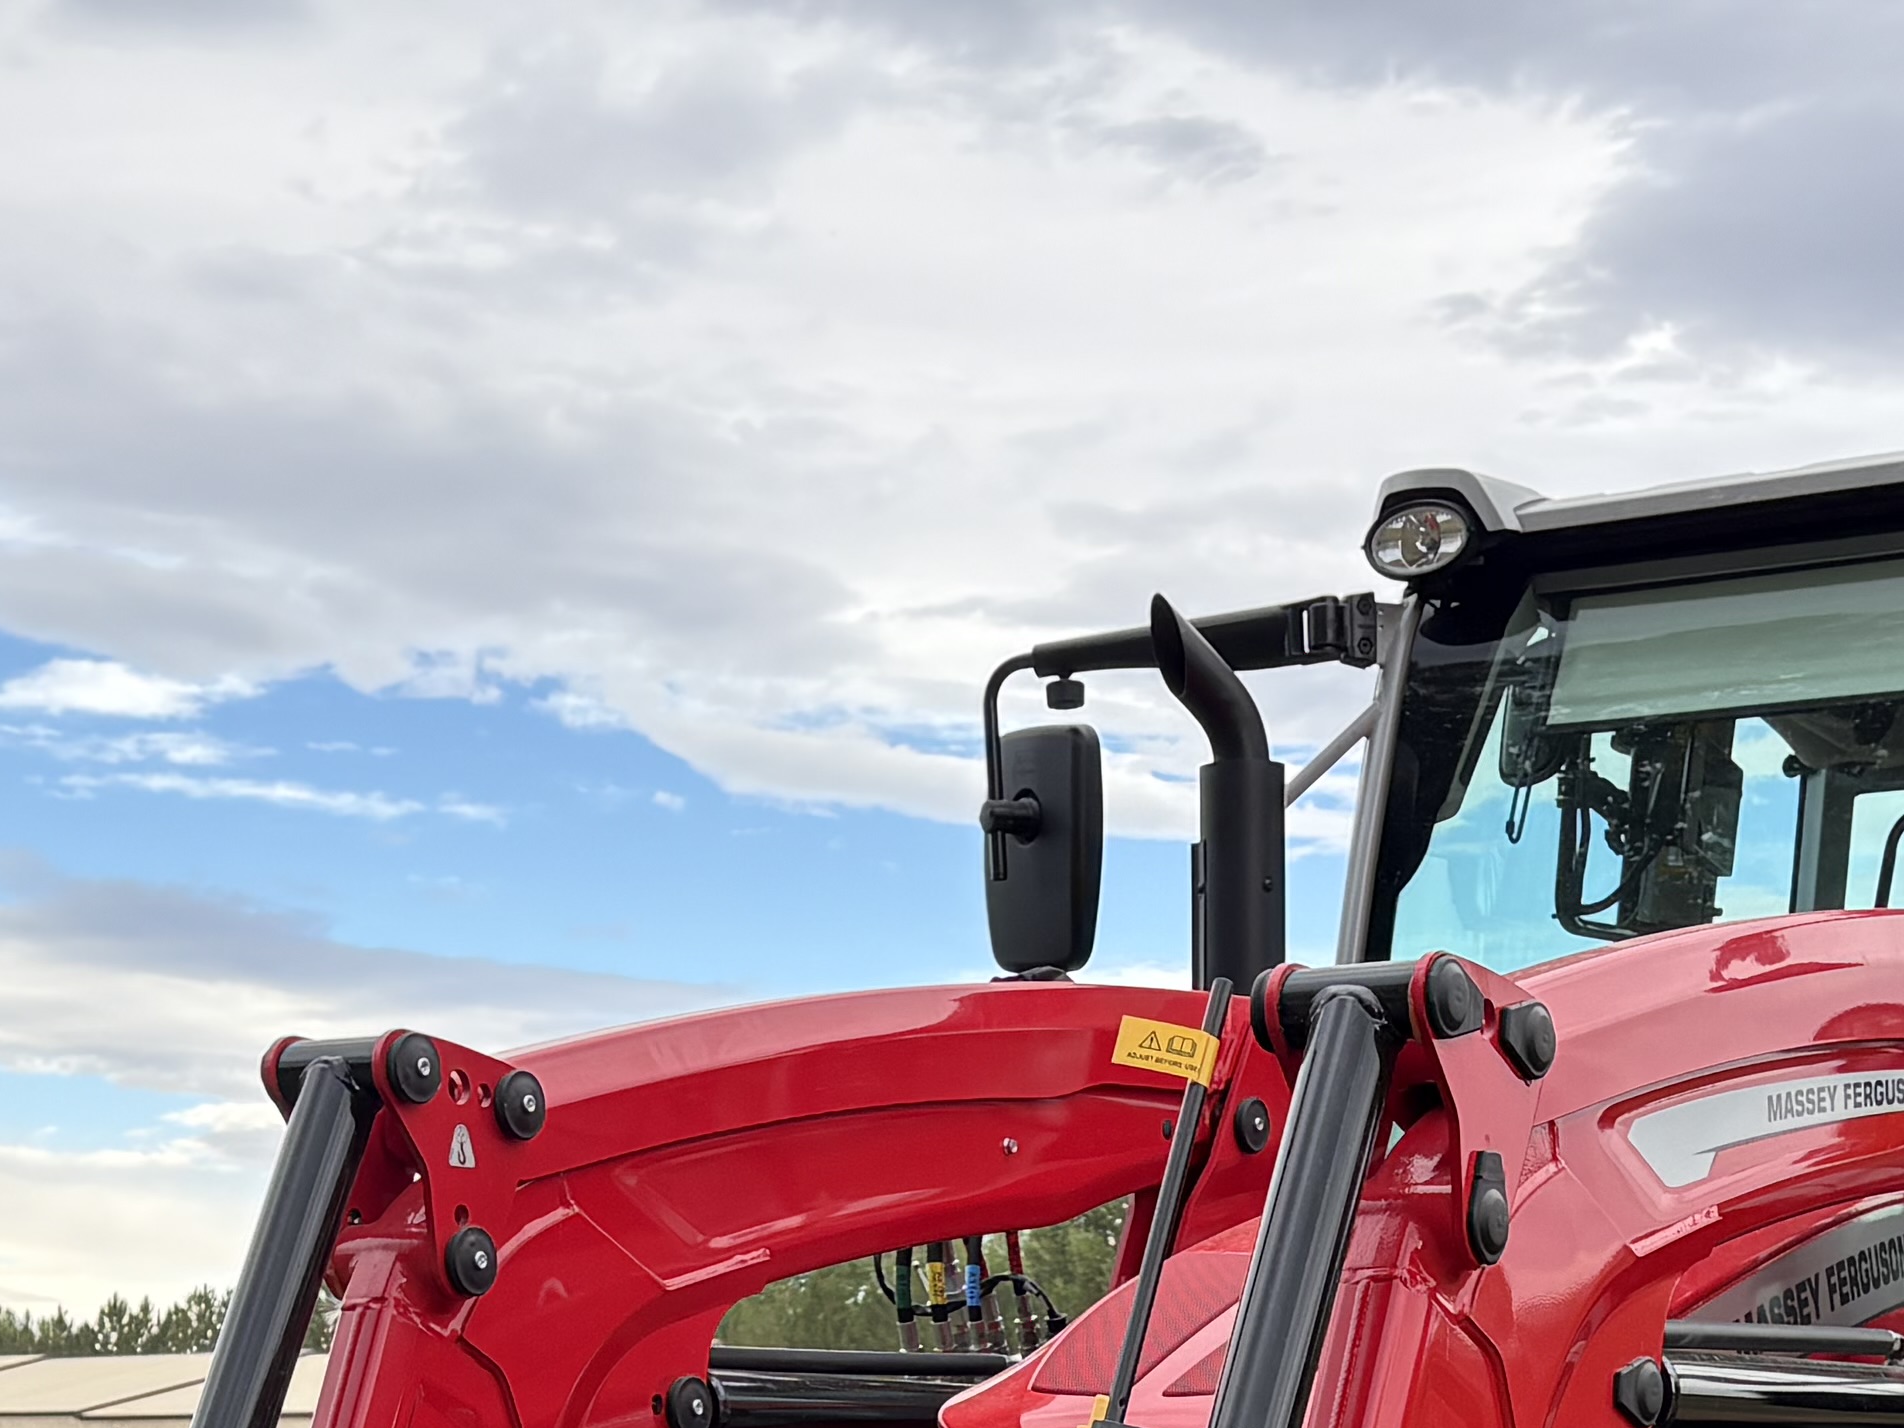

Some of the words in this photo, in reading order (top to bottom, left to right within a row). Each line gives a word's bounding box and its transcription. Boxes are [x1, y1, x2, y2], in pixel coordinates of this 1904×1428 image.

[1126, 1051, 1154, 1064] ADJUST
[1154, 1057, 1183, 1069] BEFORE
[1766, 1084, 1838, 1123] MASSEY
